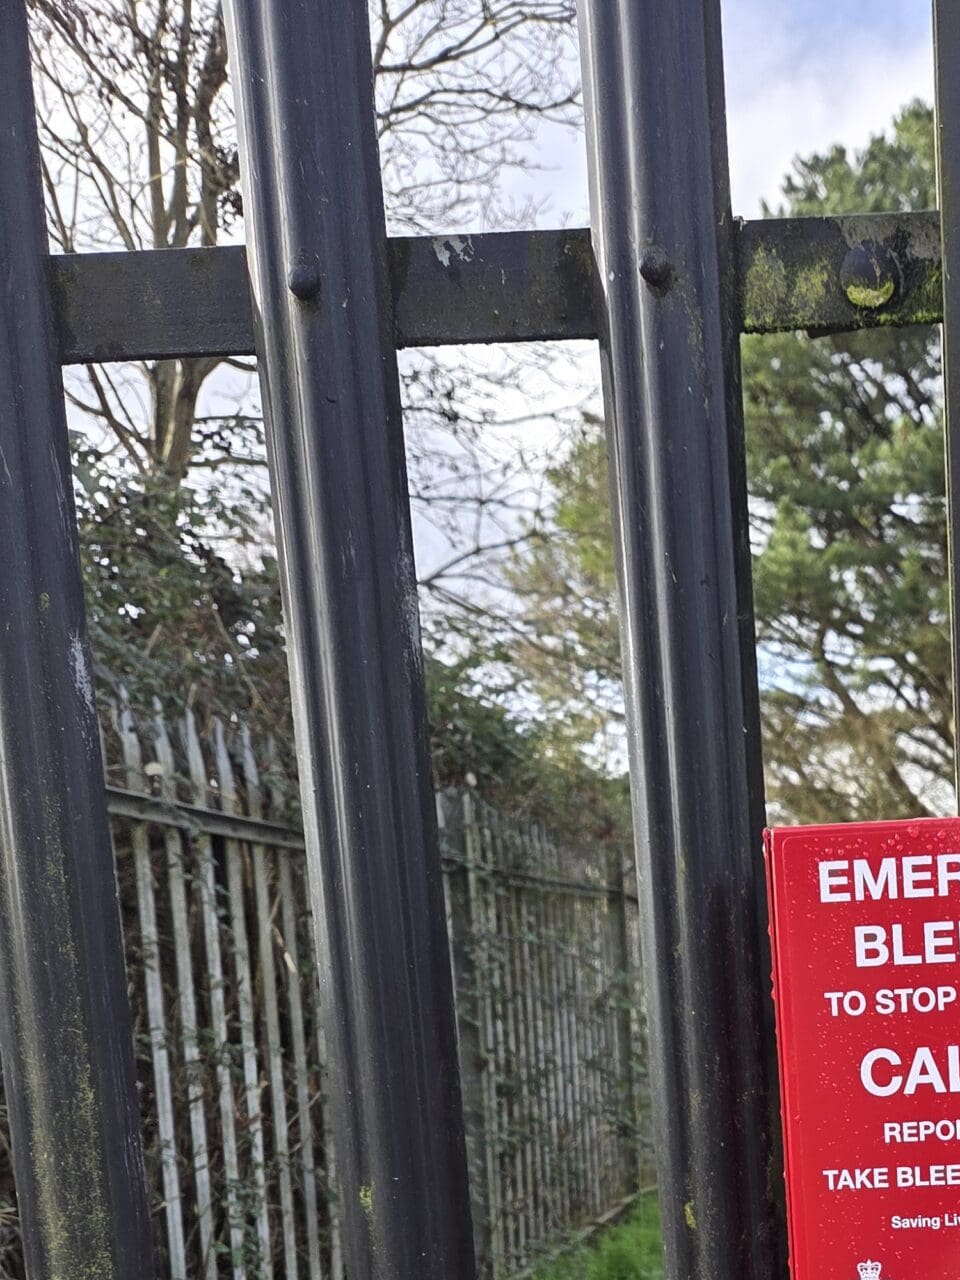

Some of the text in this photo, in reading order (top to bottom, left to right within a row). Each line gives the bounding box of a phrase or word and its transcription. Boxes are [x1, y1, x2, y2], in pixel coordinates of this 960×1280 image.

[824, 991, 866, 1016] TO
[876, 987, 956, 1014] STOP
[823, 1168, 889, 1190] TAKE
[891, 1214, 941, 1230] Saving
